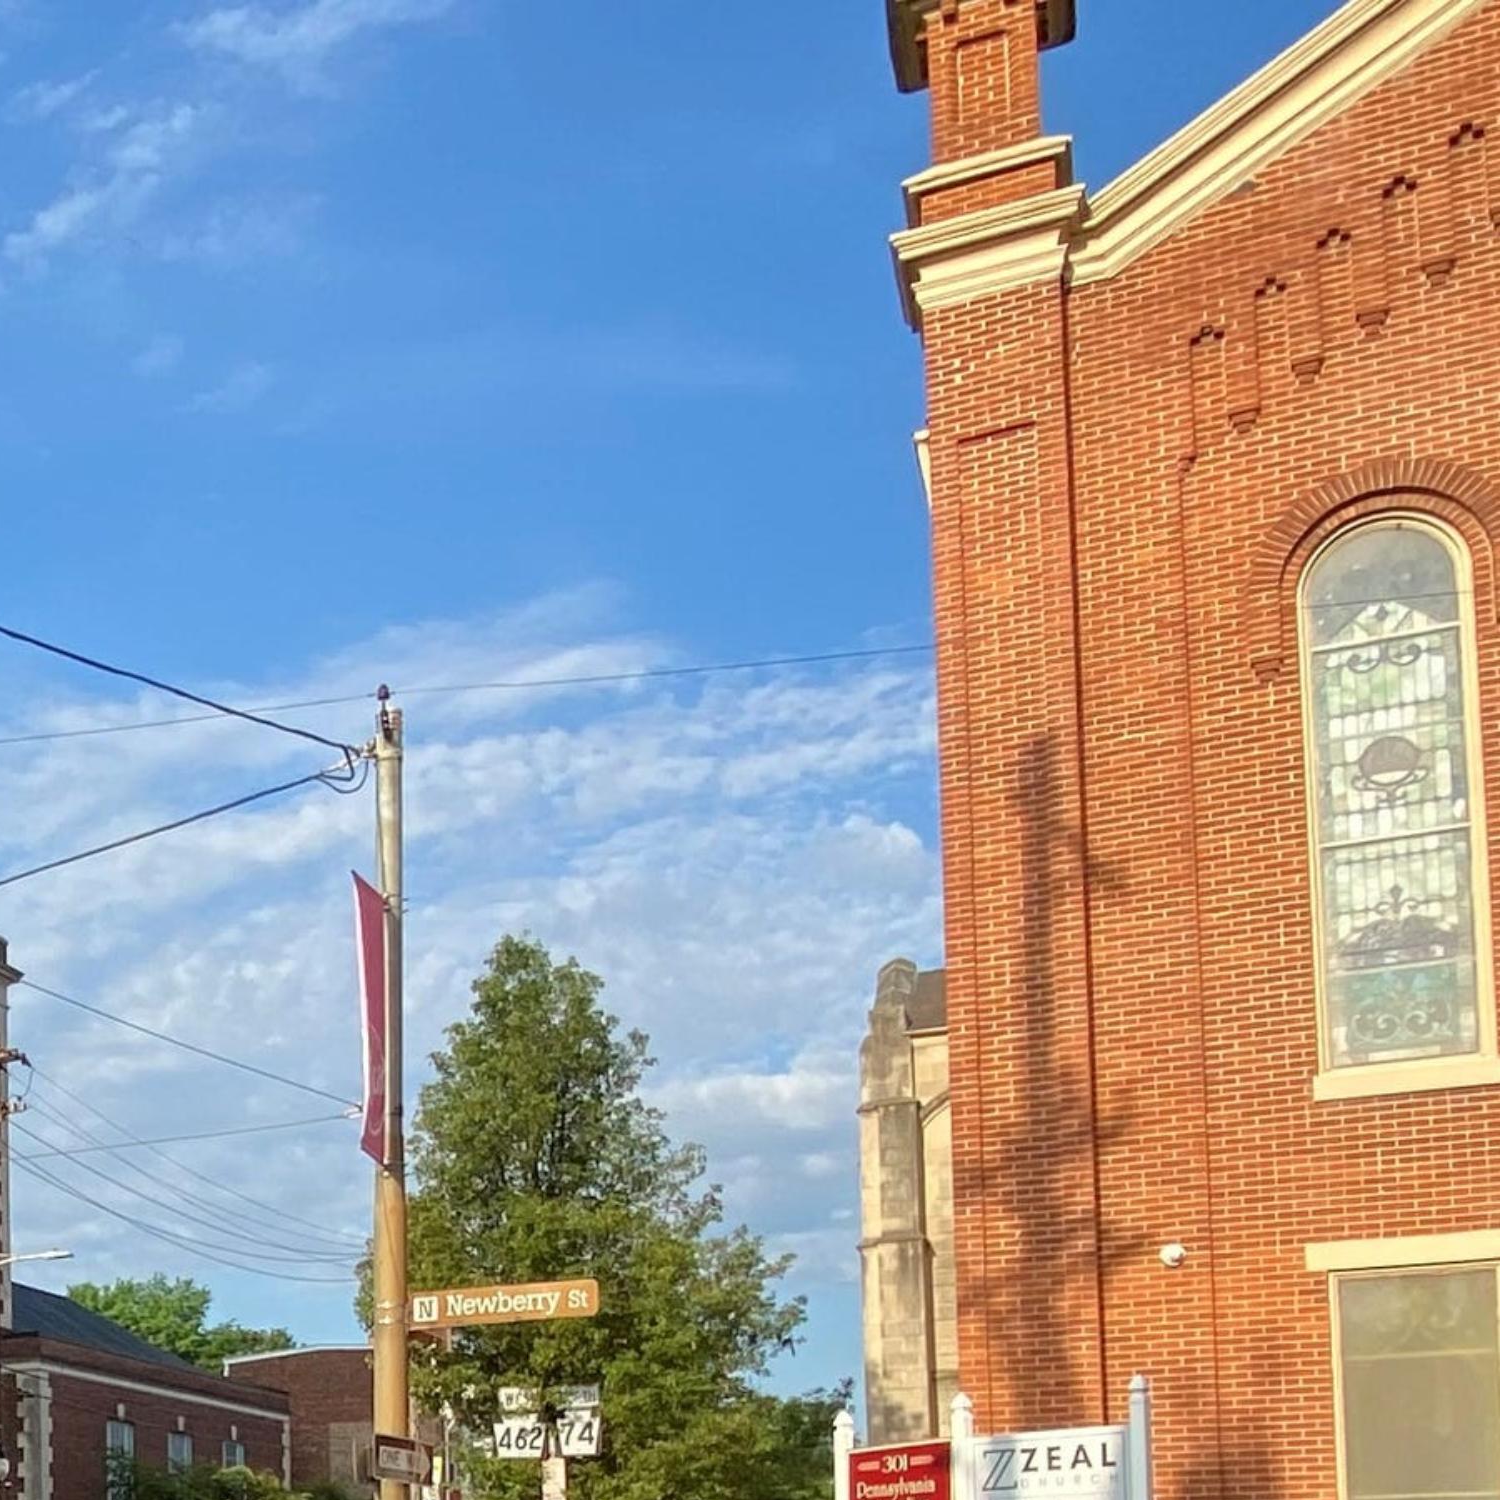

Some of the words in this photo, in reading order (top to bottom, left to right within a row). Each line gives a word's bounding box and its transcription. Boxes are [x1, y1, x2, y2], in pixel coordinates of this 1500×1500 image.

[418, 1299, 436, 1319] N
[446, 1291, 561, 1318] Newberry
[568, 1289, 588, 1309] St
[498, 1426, 542, 1450] 462
[560, 1421, 594, 1446] 74
[881, 1453, 908, 1474] 301
[1020, 1442, 1117, 1473] ZEAL
[1020, 1473, 1119, 1489] CHURCH
